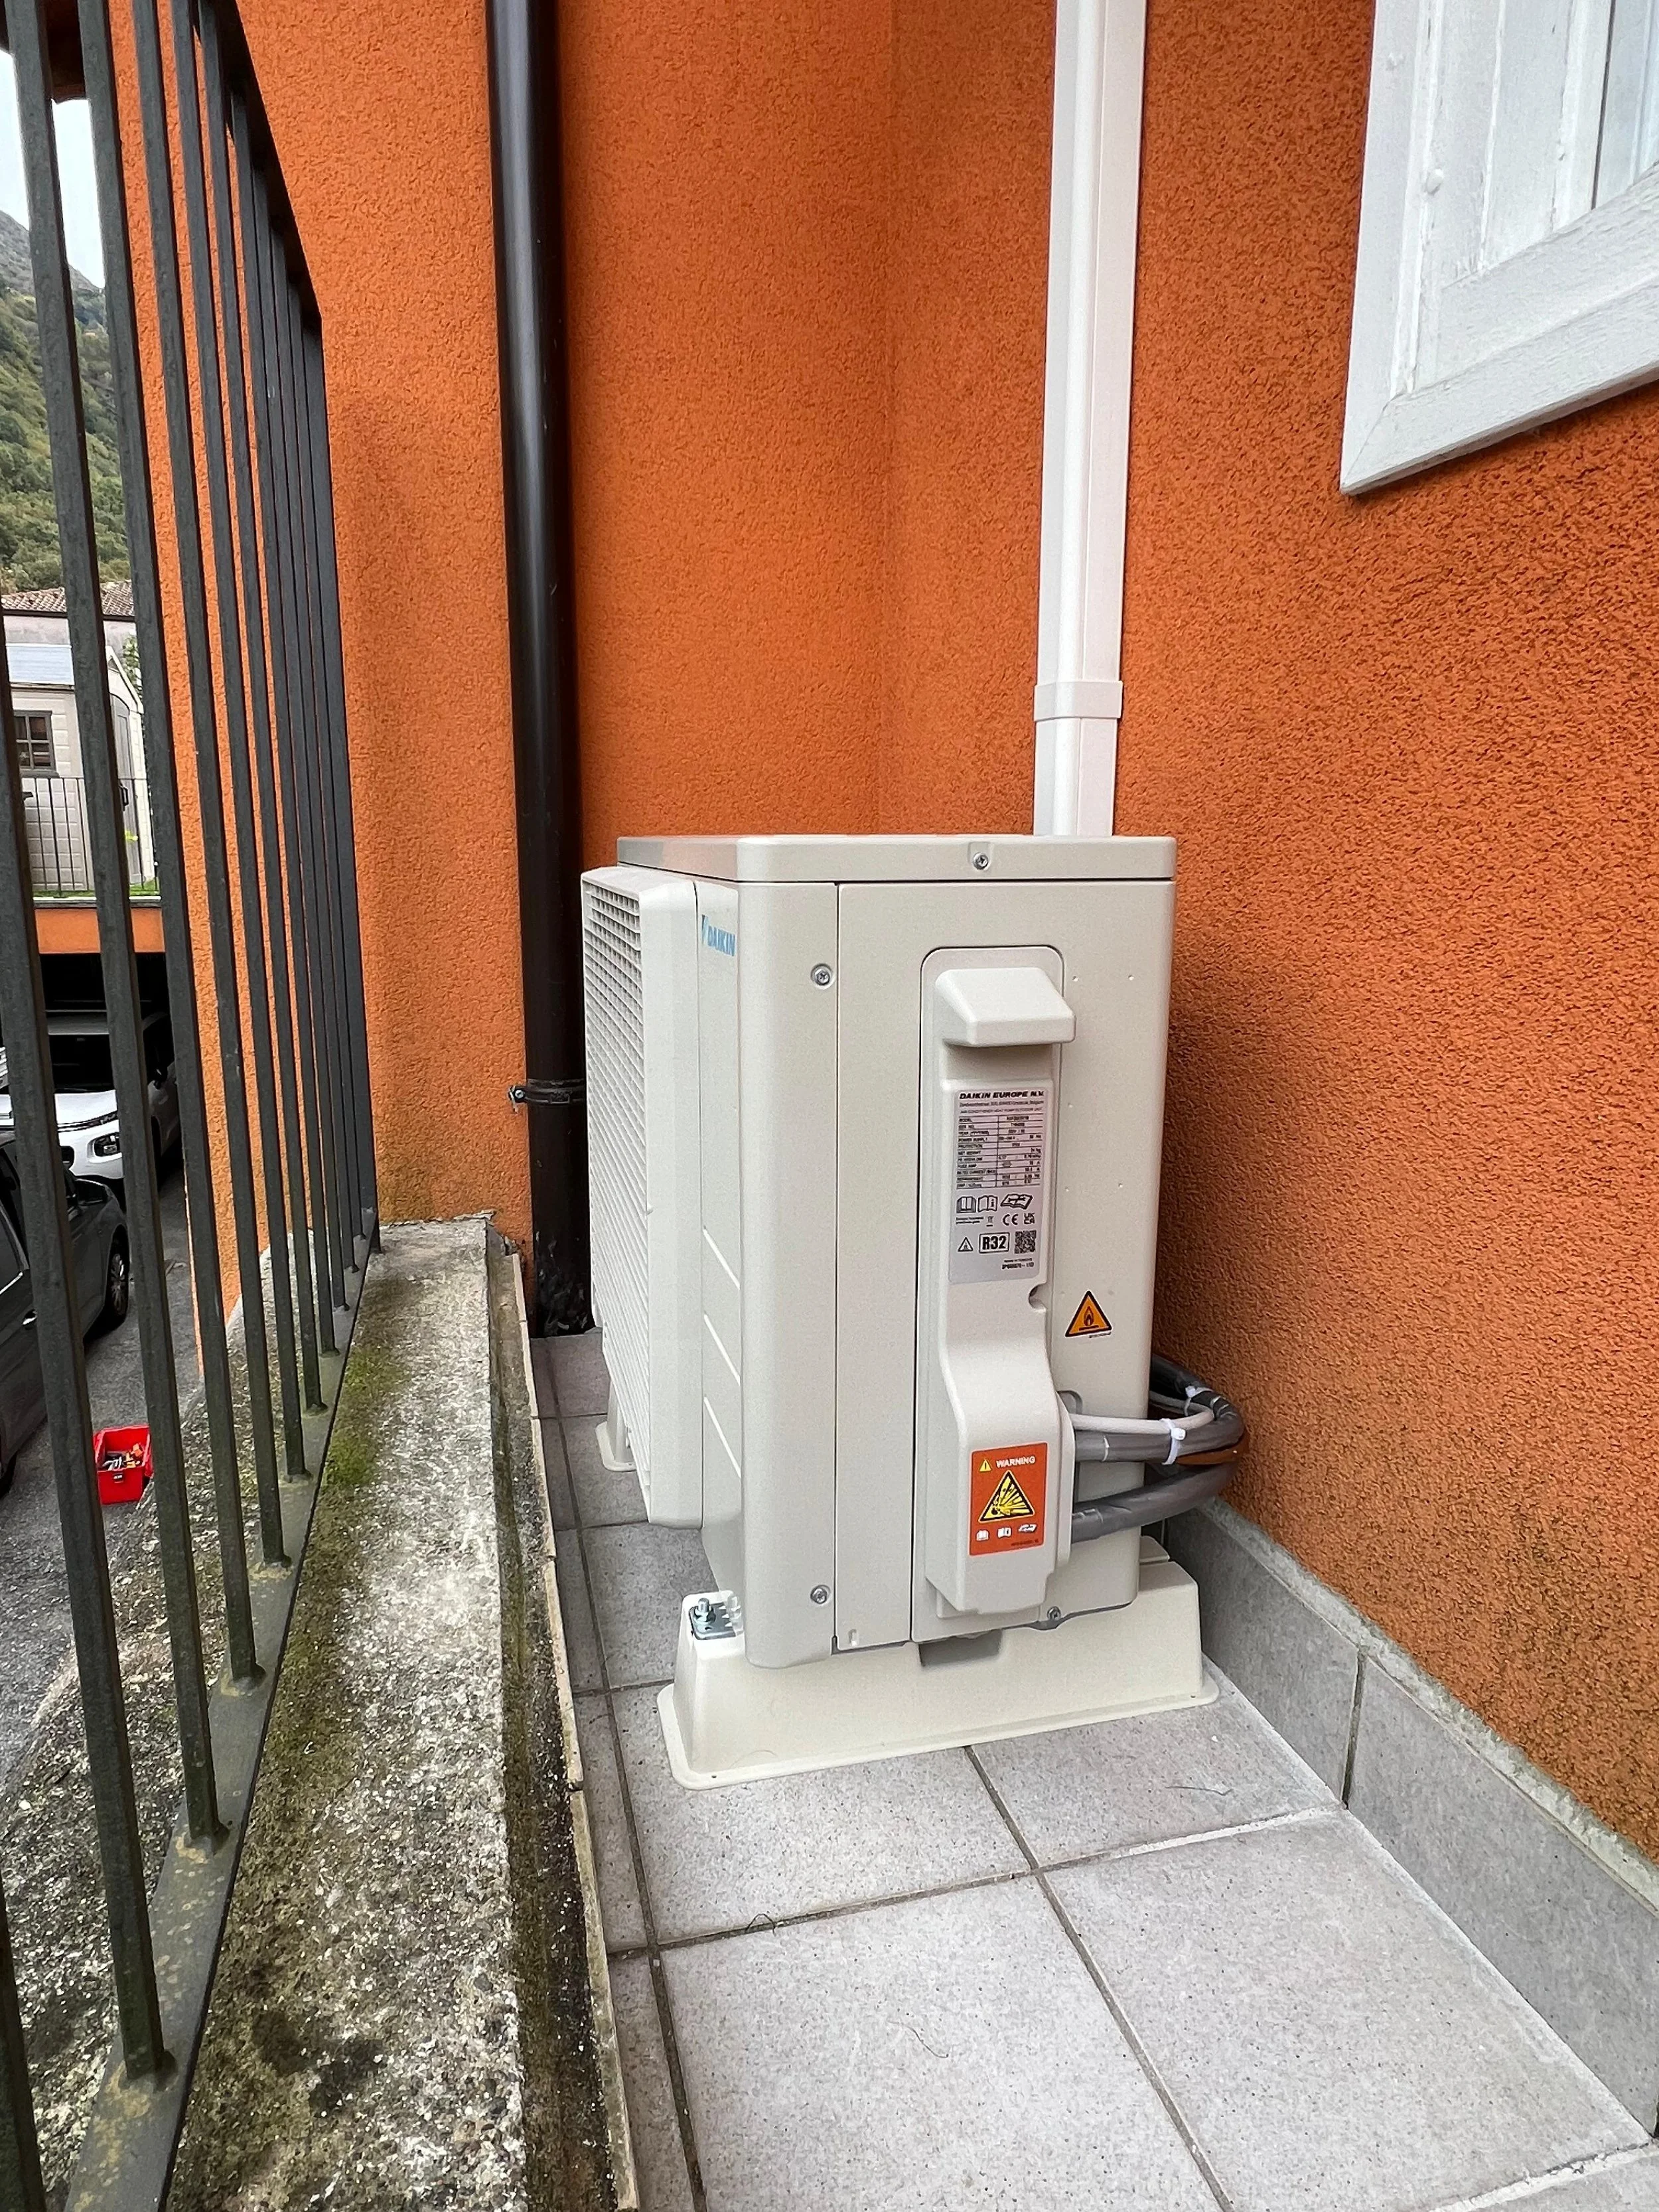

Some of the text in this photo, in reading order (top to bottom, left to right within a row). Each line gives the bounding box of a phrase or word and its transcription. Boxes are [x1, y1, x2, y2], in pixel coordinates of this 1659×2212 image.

[707, 924, 735, 957] DAIKIN
[982, 1235, 1007, 1250] R32
[996, 1455, 1036, 1468] WARNING
